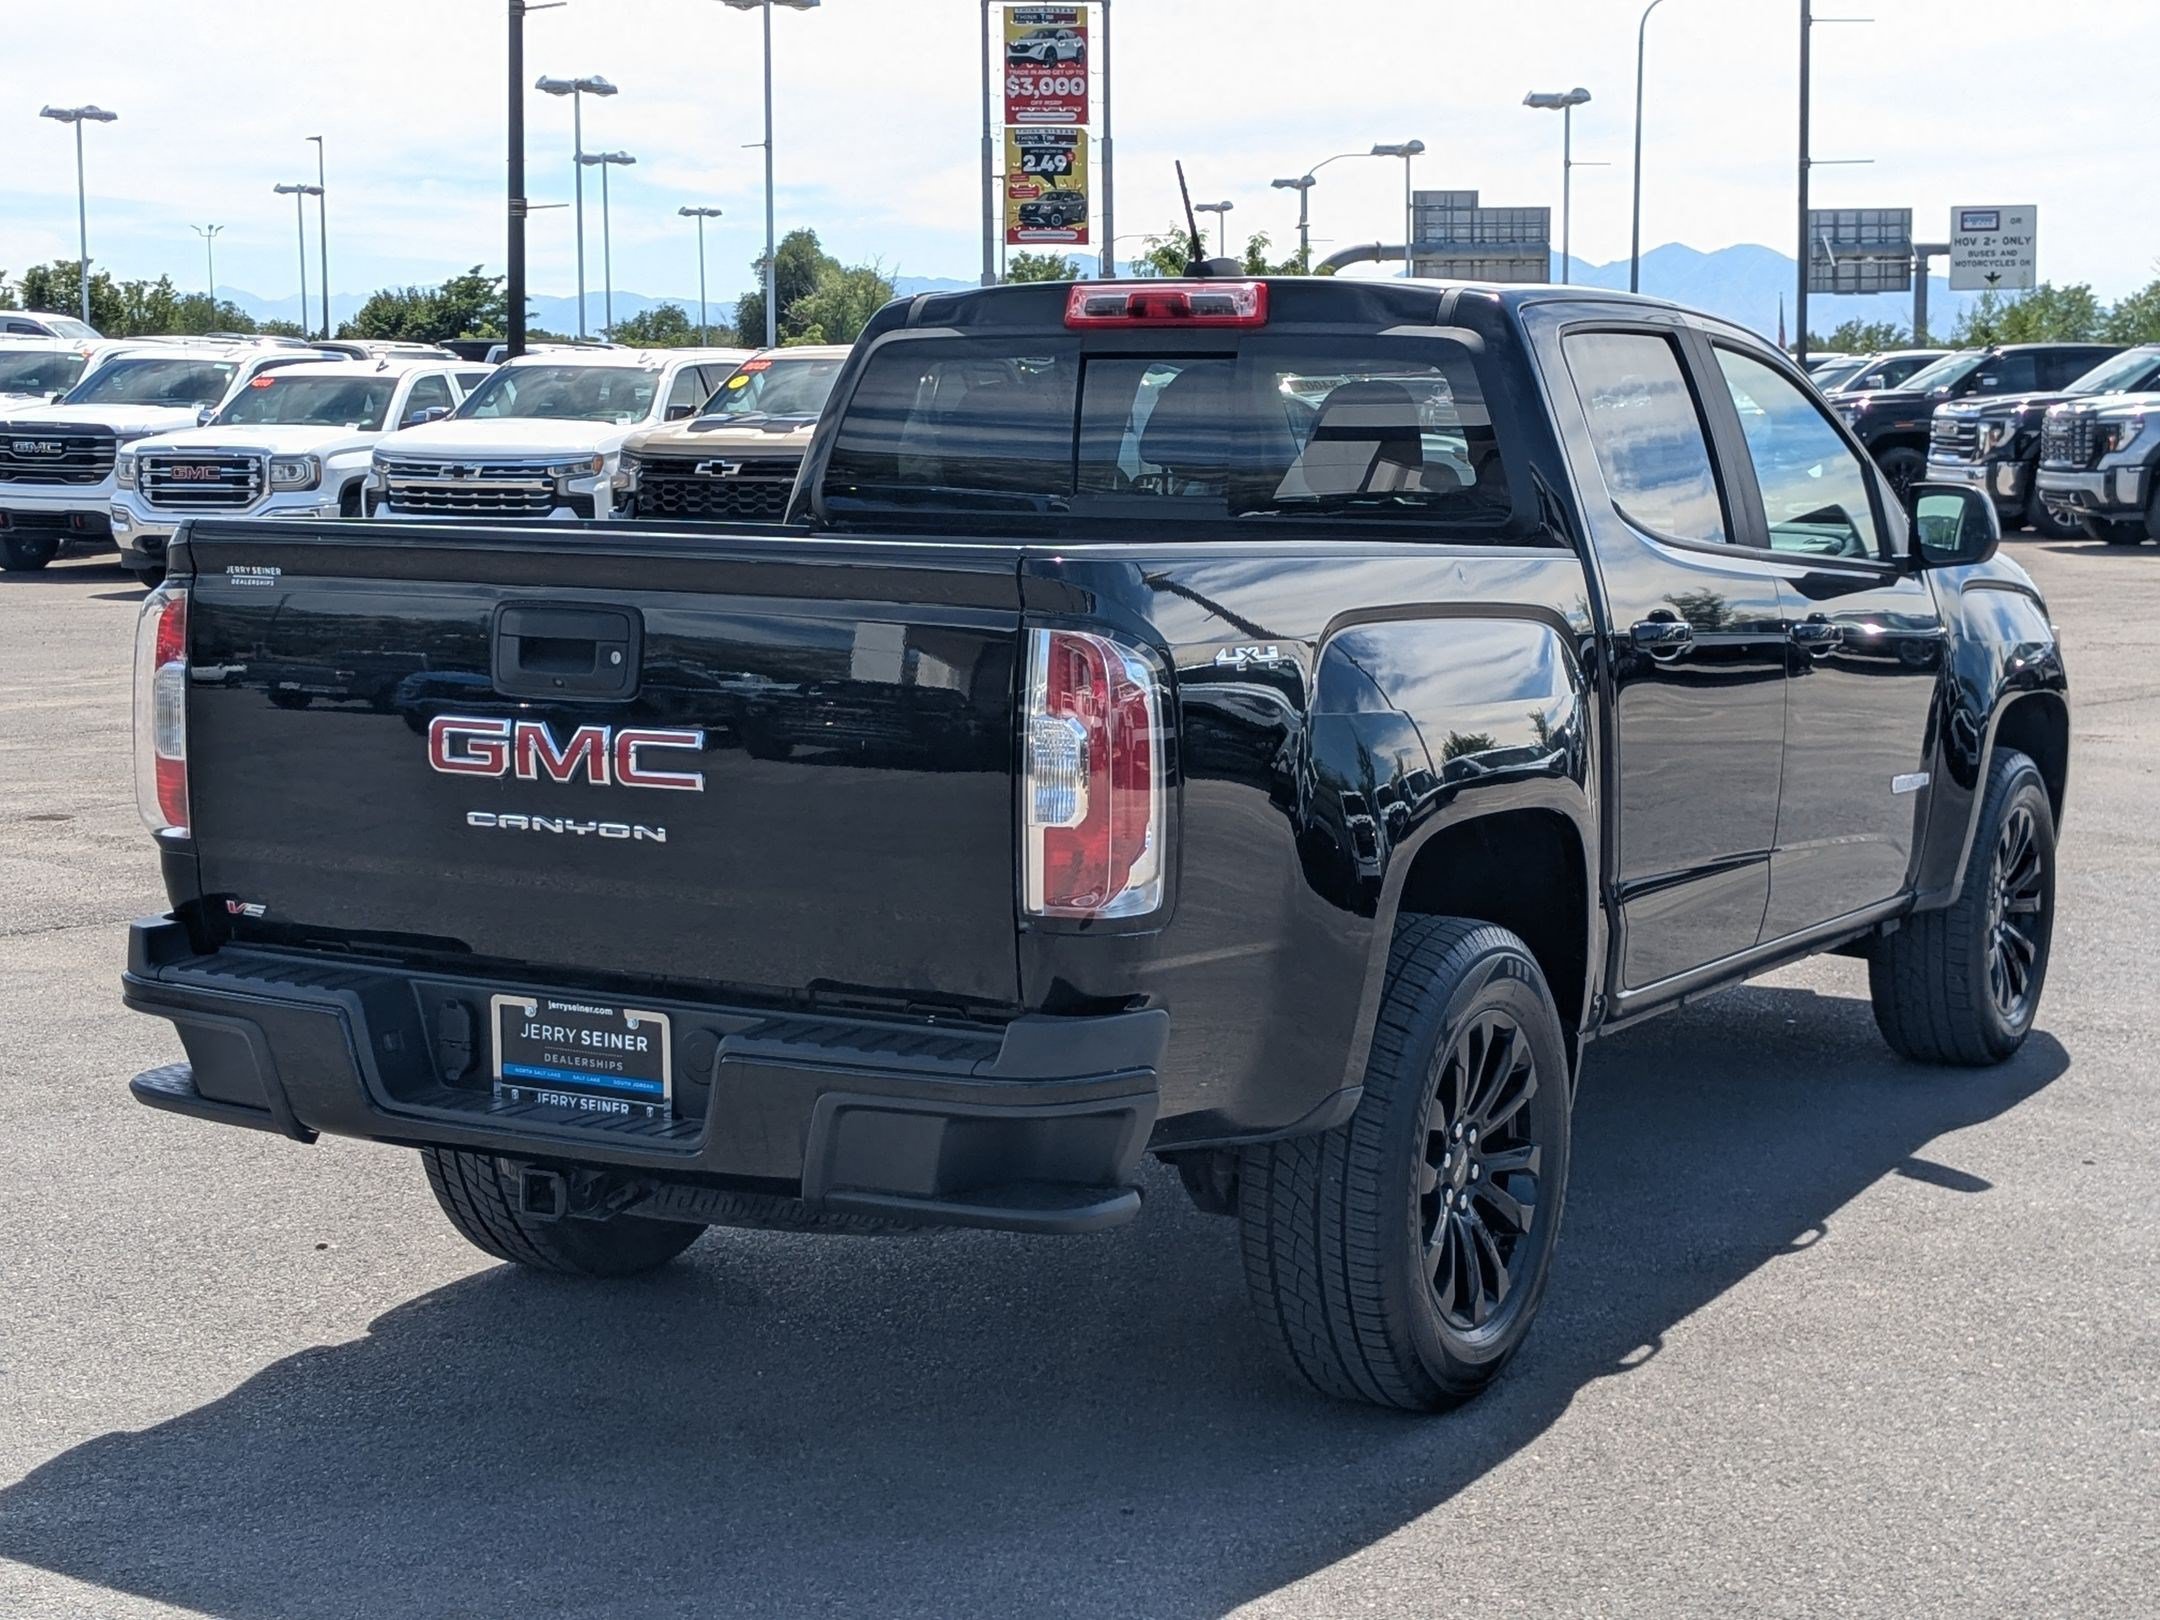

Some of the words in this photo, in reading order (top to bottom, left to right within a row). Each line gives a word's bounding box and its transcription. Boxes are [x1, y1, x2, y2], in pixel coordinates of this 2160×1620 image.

[1006, 75, 1085, 98] $3,000
[1023, 154, 1067, 172] 2.49
[1954, 237, 1977, 246] HOV
[2002, 236, 2032, 245] ONLY
[13, 441, 62, 453] GMC
[170, 466, 220, 480] GMC
[226, 566, 250, 574] JERRY
[252, 567, 281, 575] SEINER
[428, 715, 704, 792] GMC
[466, 811, 666, 842] CANYON
[226, 900, 266, 917] V6
[548, 1000, 613, 1015] jerryseiner.com
[521, 1023, 577, 1043] JERRY
[581, 1030, 648, 1052] SEINER
[544, 1053, 623, 1071] DEALERSHIPS
[534, 1092, 577, 1108] JERRY
[580, 1098, 629, 1114] SEINER
